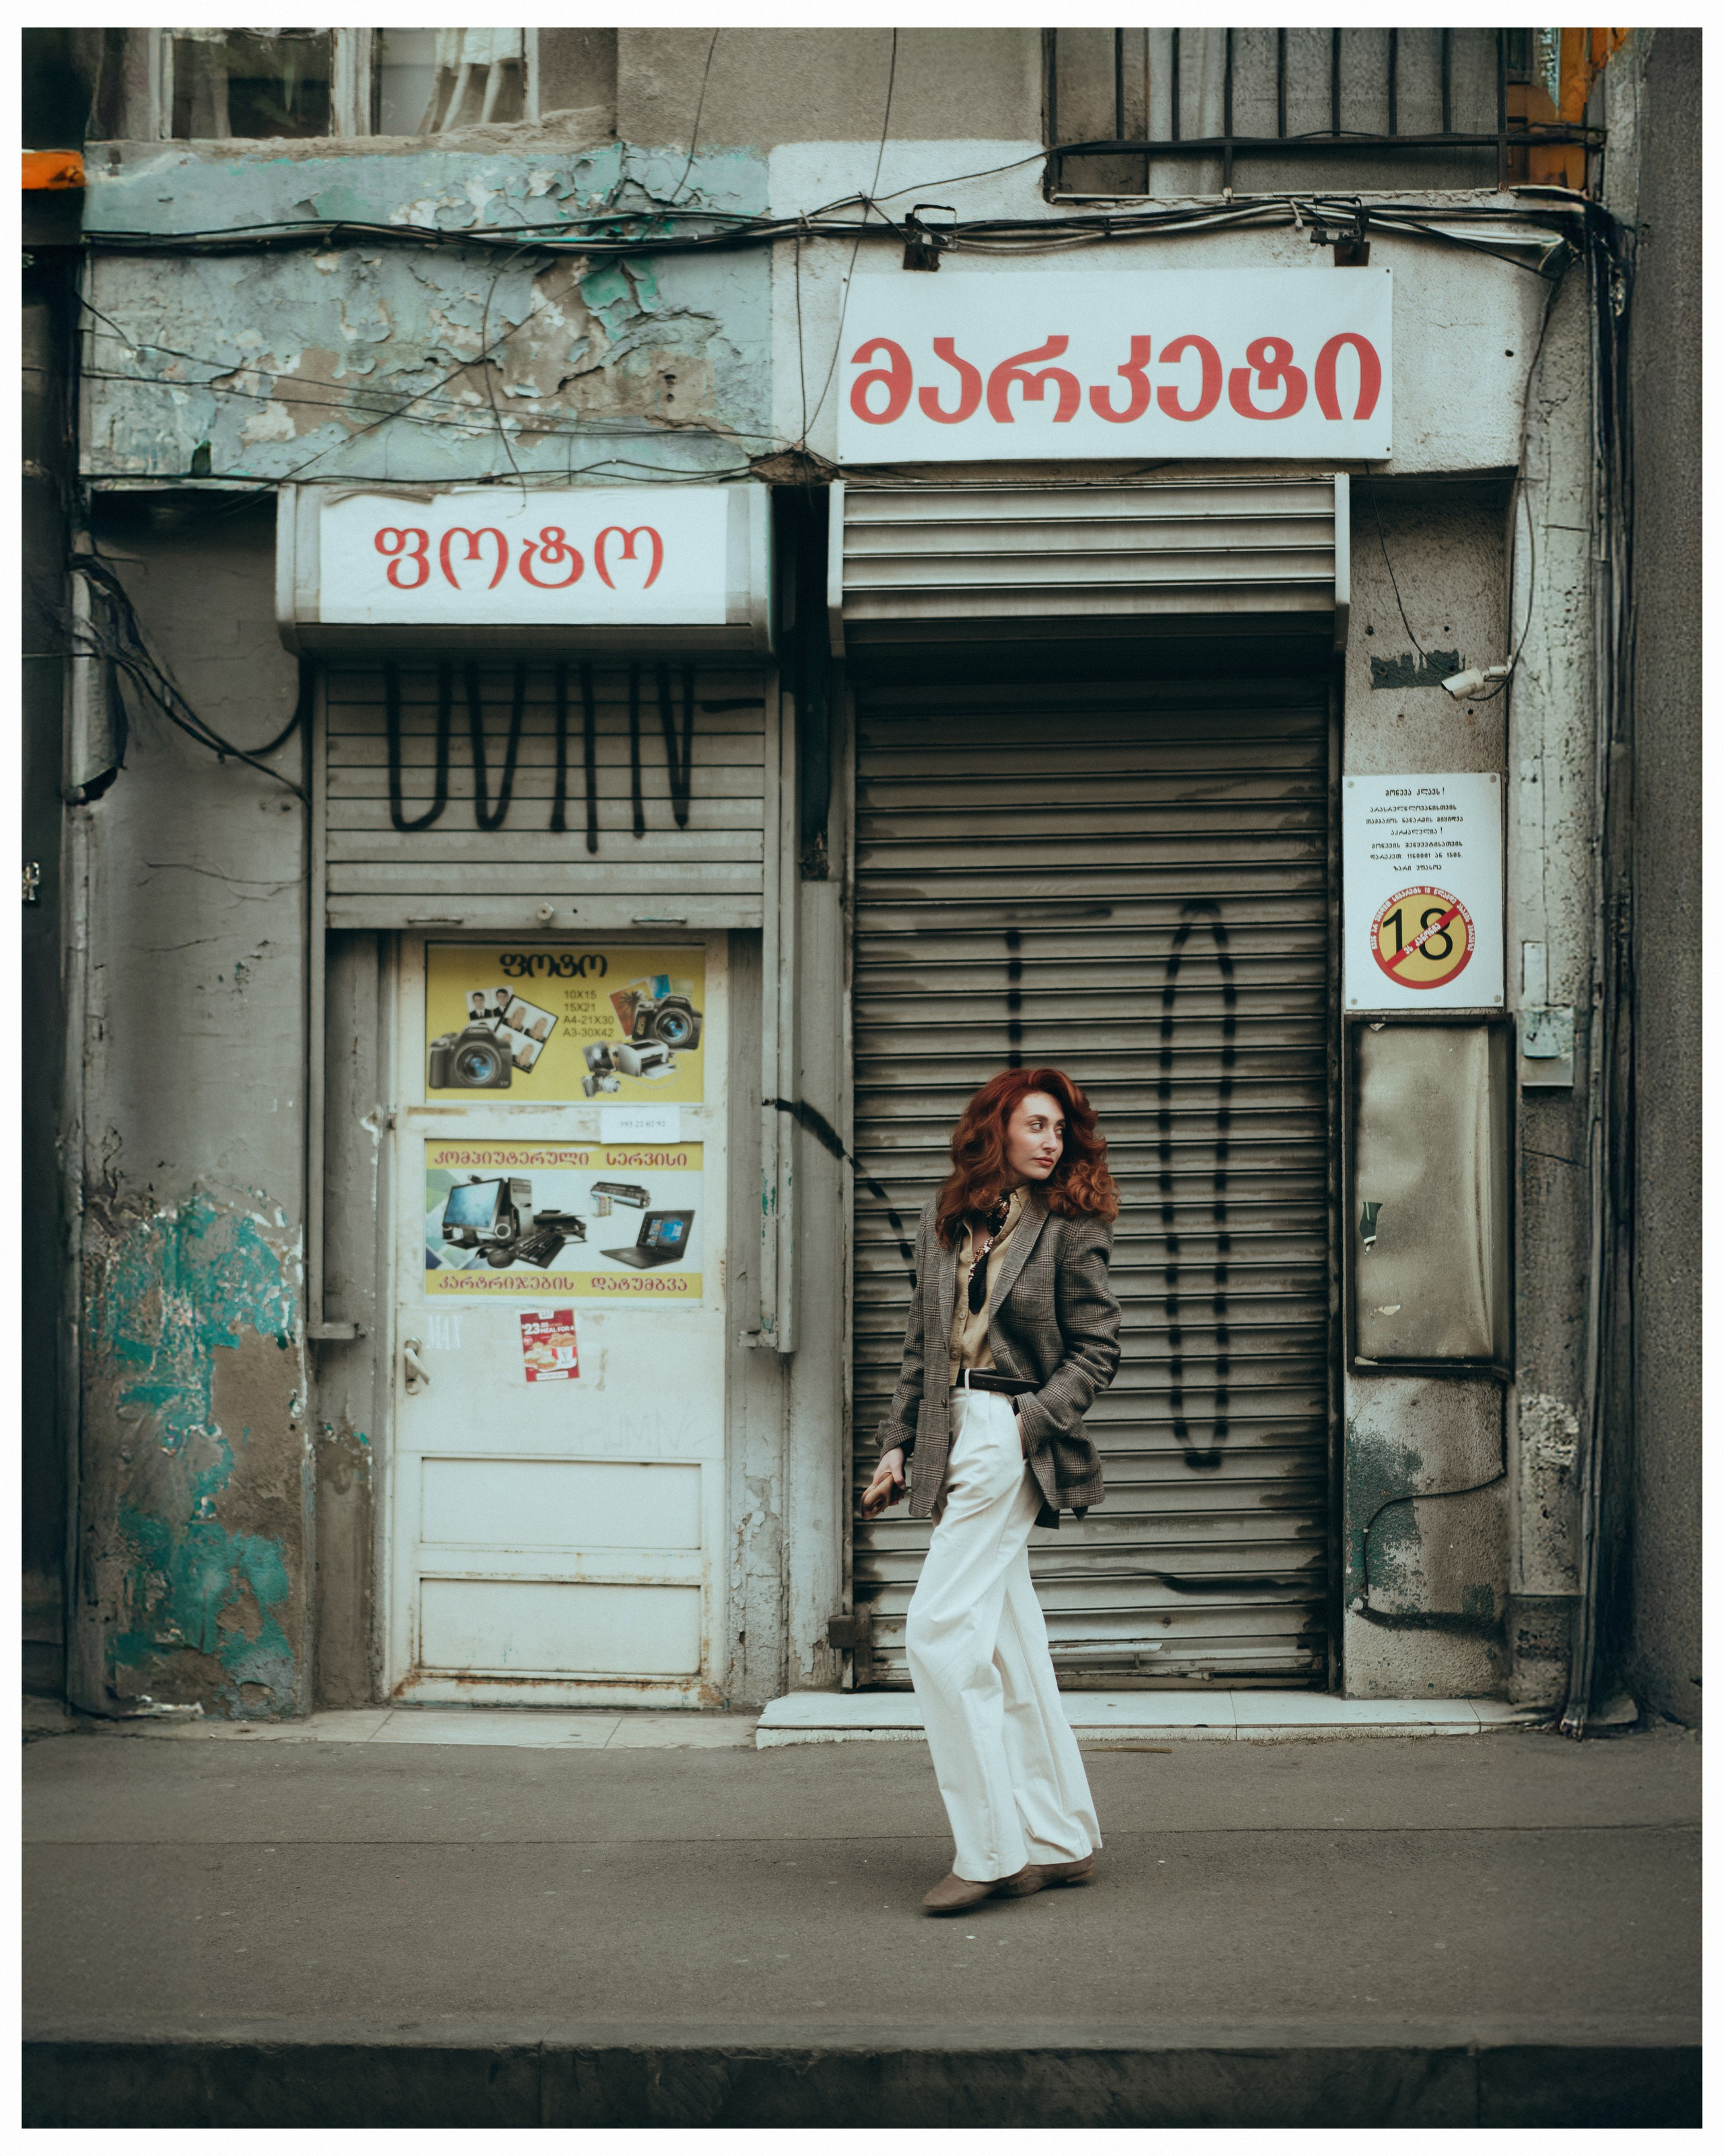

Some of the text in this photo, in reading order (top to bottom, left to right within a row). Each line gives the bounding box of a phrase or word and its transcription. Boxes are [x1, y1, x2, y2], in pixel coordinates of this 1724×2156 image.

[850, 332, 1382, 424] მარკეტი
[374, 525, 664, 590] ფოტო
[1383, 908, 1453, 960] 18
[1403, 922, 1441, 955] ეს კანონია
[500, 953, 608, 978] ფოტო
[564, 990, 597, 1000] 10X15
[564, 1003, 596, 1012] 15X21
[563, 1016, 614, 1025] A4-21X30
[563, 1028, 614, 1038] A3-30X42
[434, 1150, 688, 1167] კომპიუტერული სერვისი
[438, 1276, 688, 1293] კარტრიჯების დატუმბვა
